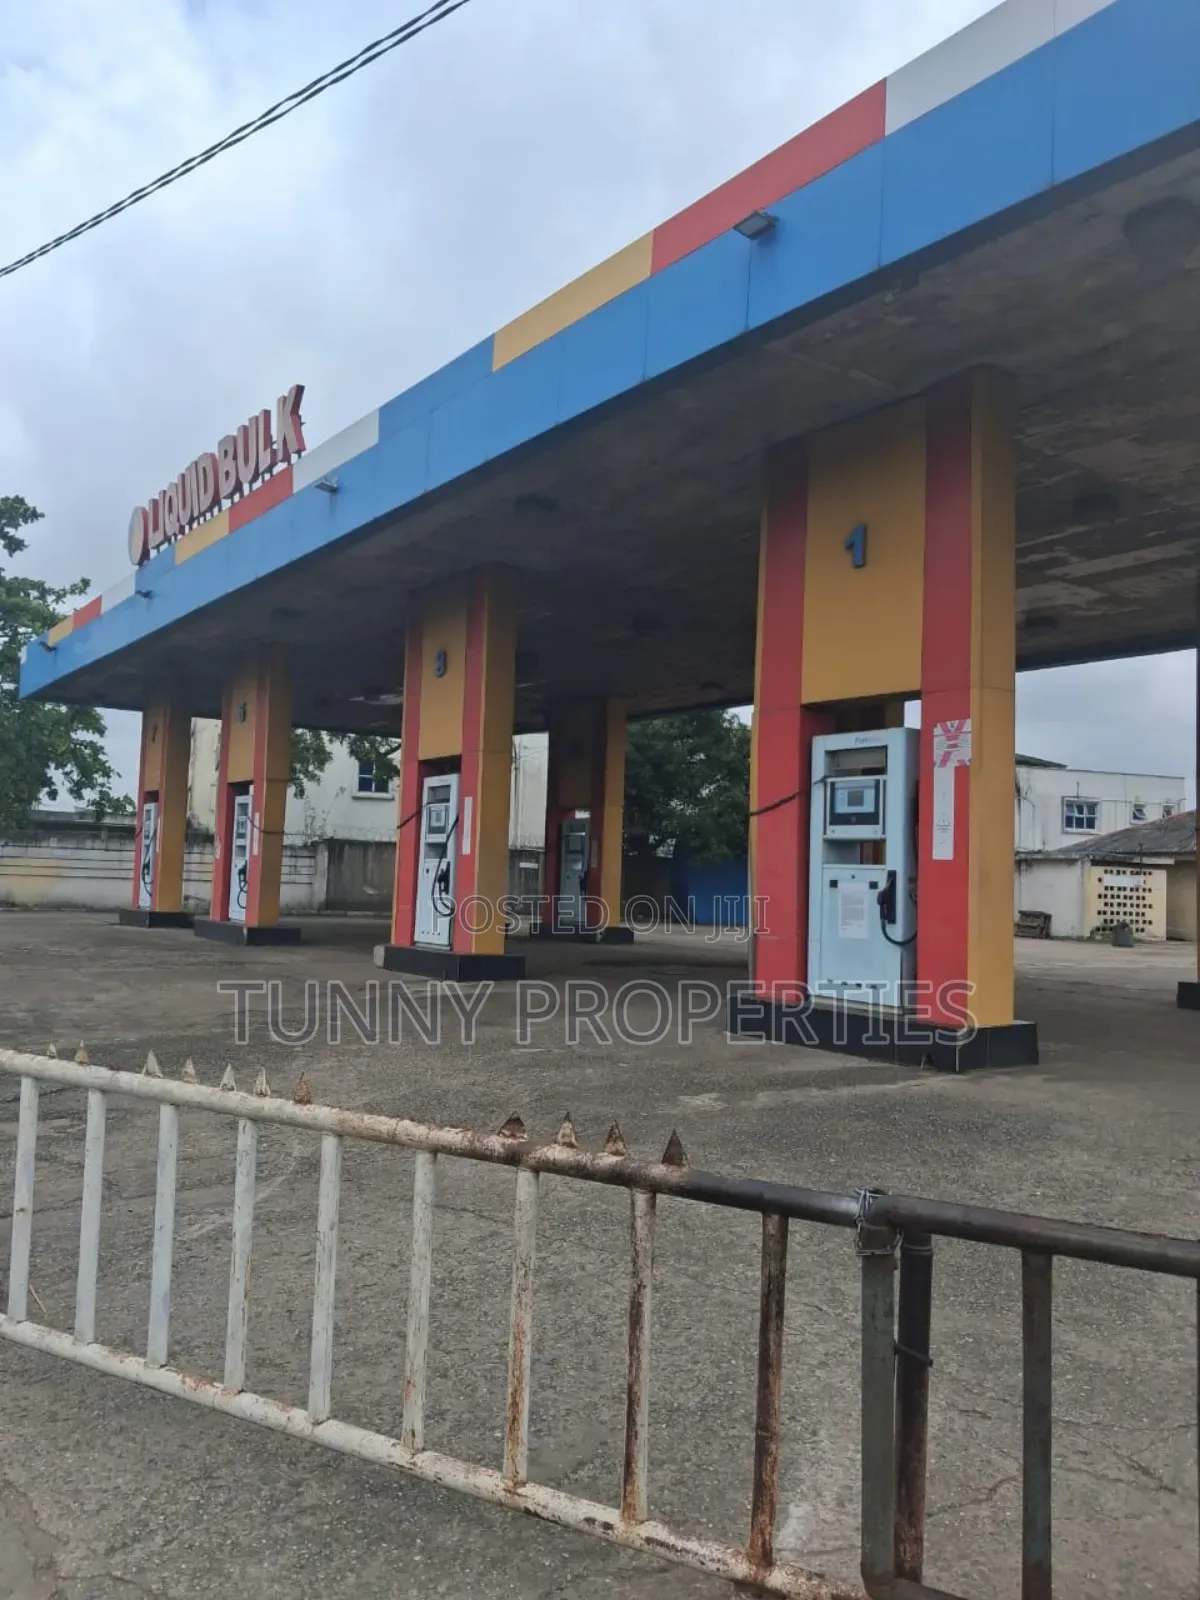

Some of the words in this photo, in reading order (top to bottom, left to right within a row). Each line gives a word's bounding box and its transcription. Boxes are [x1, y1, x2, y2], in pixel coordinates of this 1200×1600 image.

[148, 451, 221, 549] LIQUID
[218, 384, 306, 500] BULK
[843, 524, 867, 569] 1
